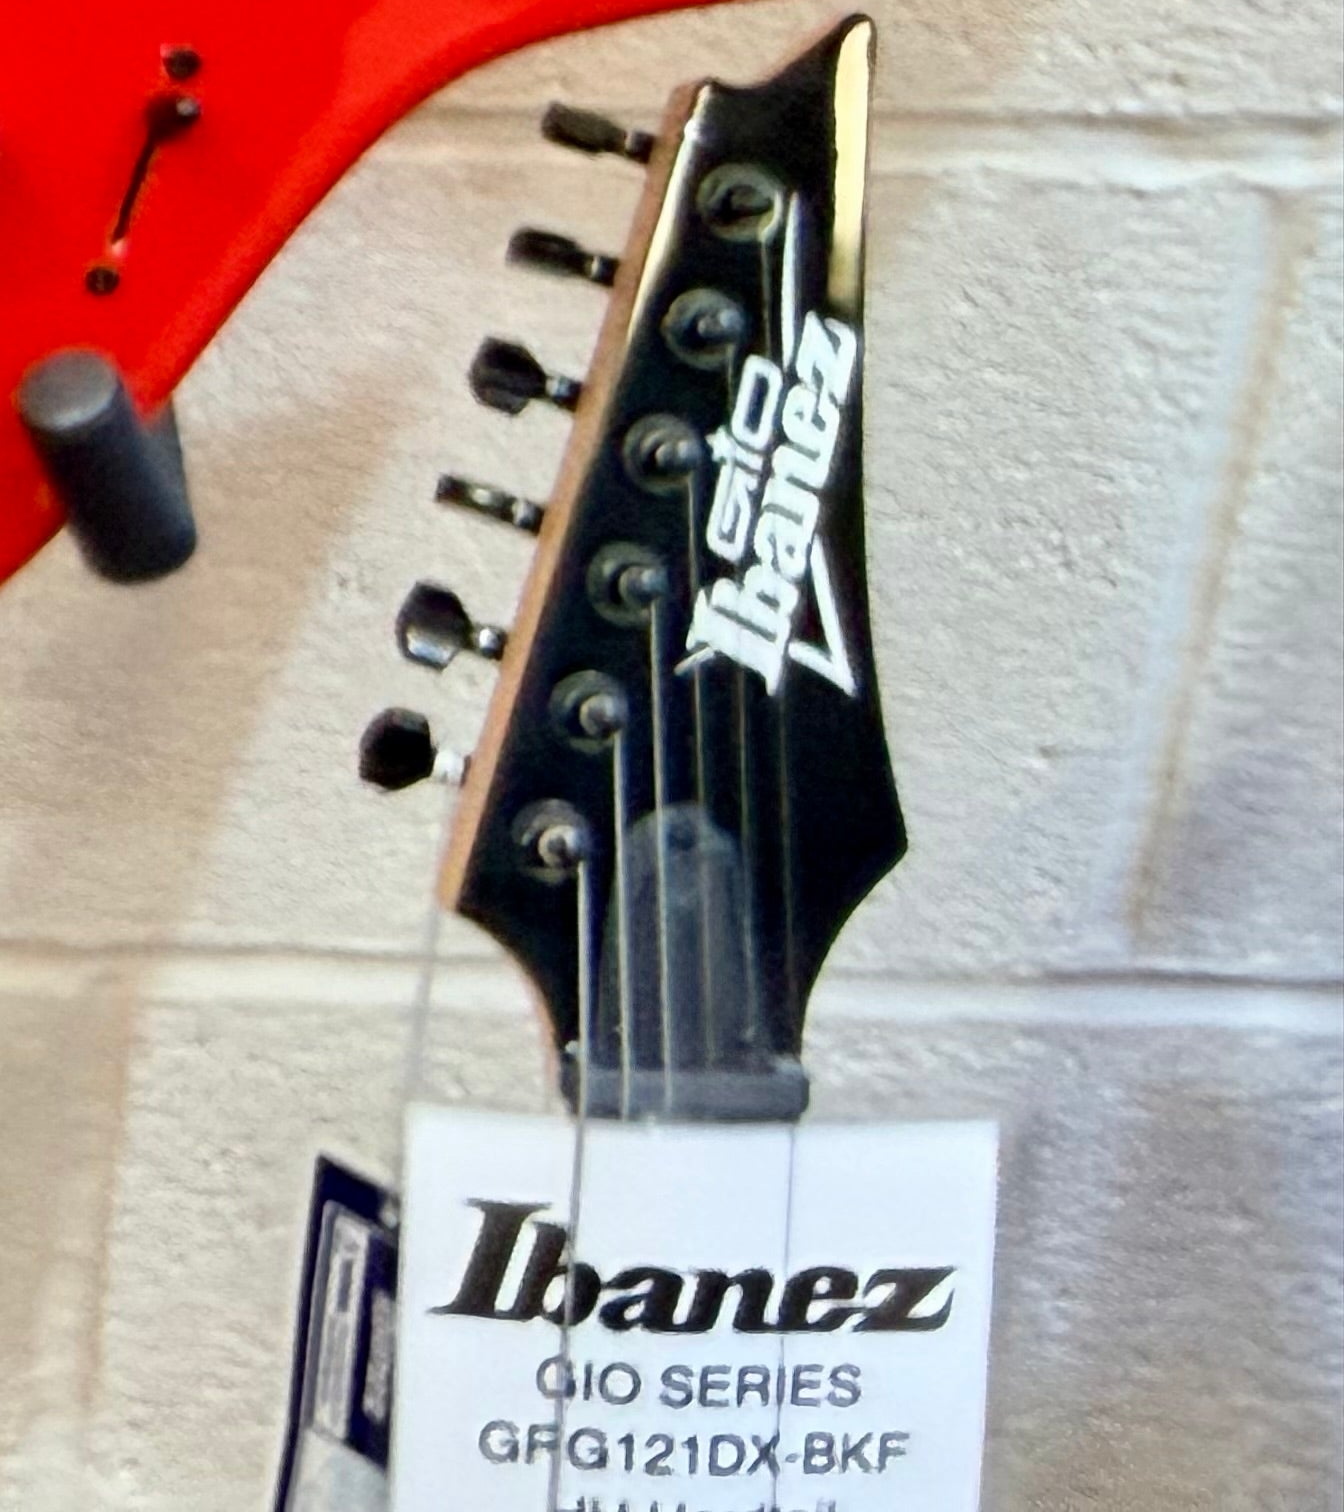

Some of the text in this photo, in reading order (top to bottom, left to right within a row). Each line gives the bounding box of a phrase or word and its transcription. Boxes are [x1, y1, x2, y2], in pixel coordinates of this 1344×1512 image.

[686, 310, 858, 696] Ibanez
[426, 1196, 958, 1335] Ibanez
[536, 1354, 862, 1408] GIO SERIES
